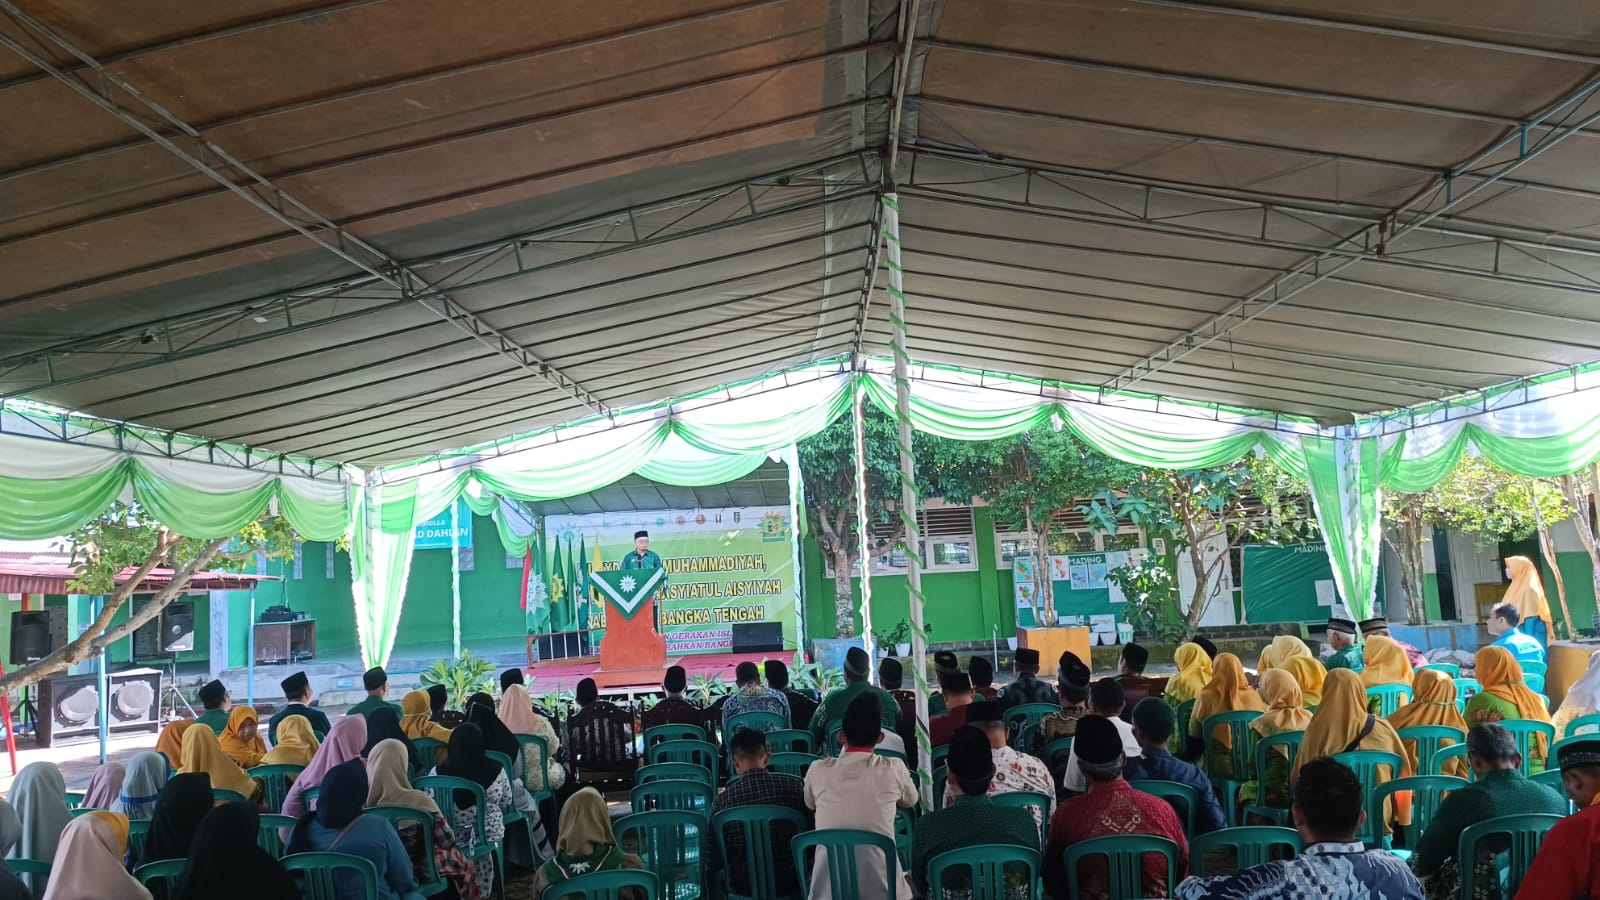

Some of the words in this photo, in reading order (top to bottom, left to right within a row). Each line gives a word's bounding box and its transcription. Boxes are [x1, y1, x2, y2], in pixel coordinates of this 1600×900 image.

[662, 554, 767, 573] MUHAMMADIYAH,
[1069, 556, 1102, 565] MADING
[659, 582, 722, 599] ASYIATUL
[724, 579, 781, 597] AISYIYAH
[660, 609, 711, 625] BANGKA
[713, 606, 765, 623] TENGAH
[672, 631, 715, 640] GERAKAN
